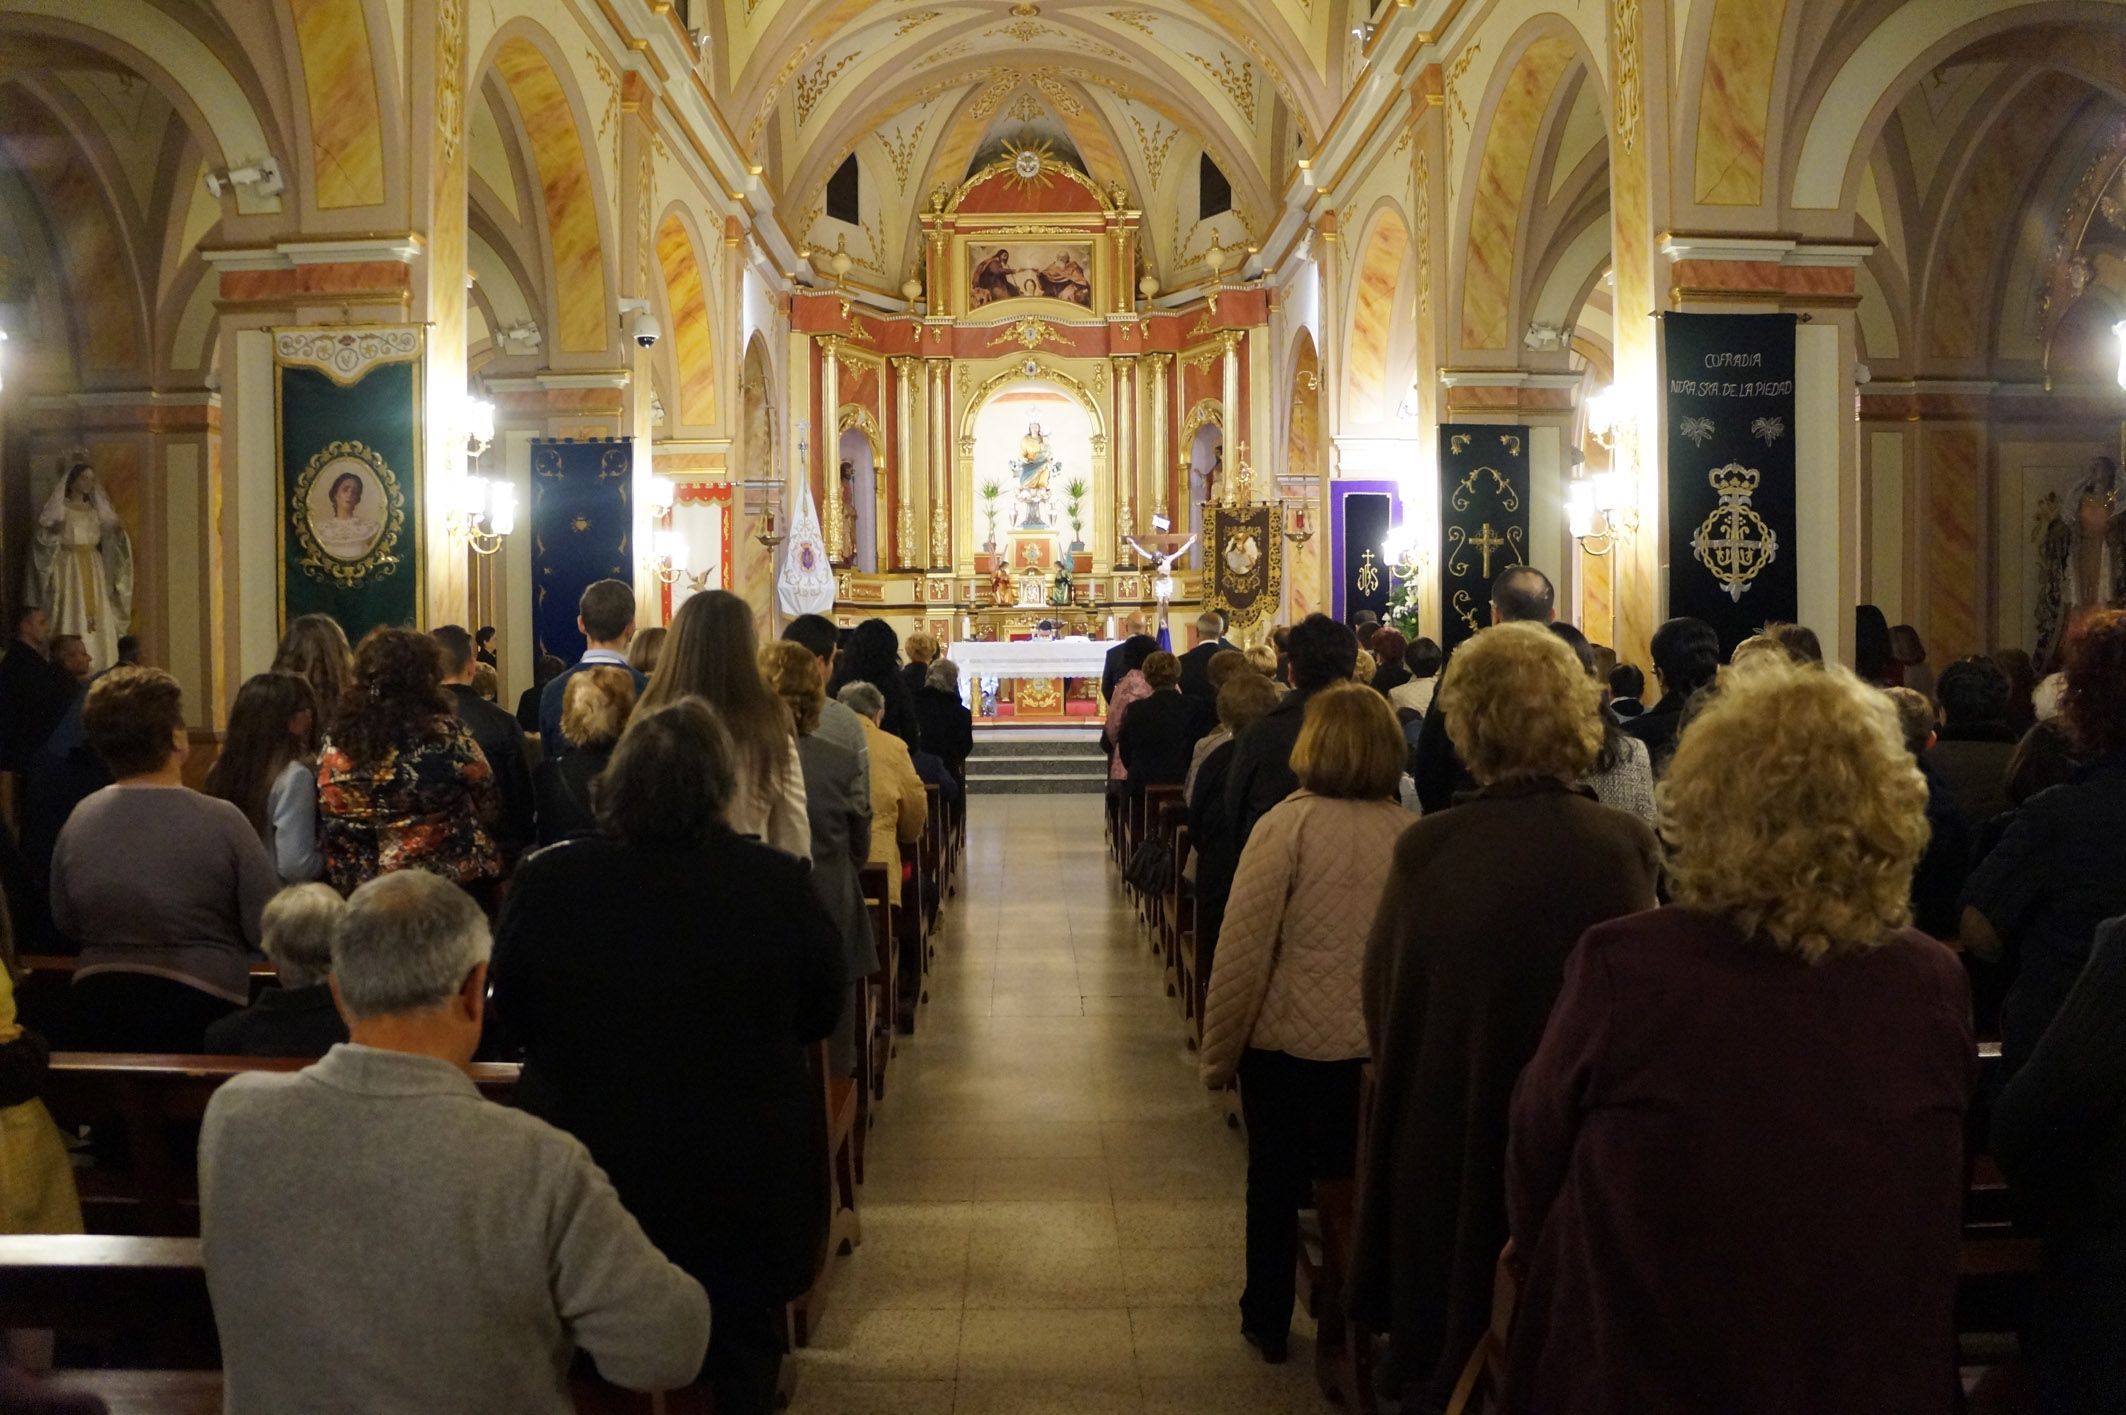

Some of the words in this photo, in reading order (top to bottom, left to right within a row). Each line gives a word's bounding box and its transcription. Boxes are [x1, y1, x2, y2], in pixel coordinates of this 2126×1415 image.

[1722, 383, 1737, 397] DE
[1739, 382, 1753, 398] LA
[1754, 380, 1793, 397] PIEDAD
